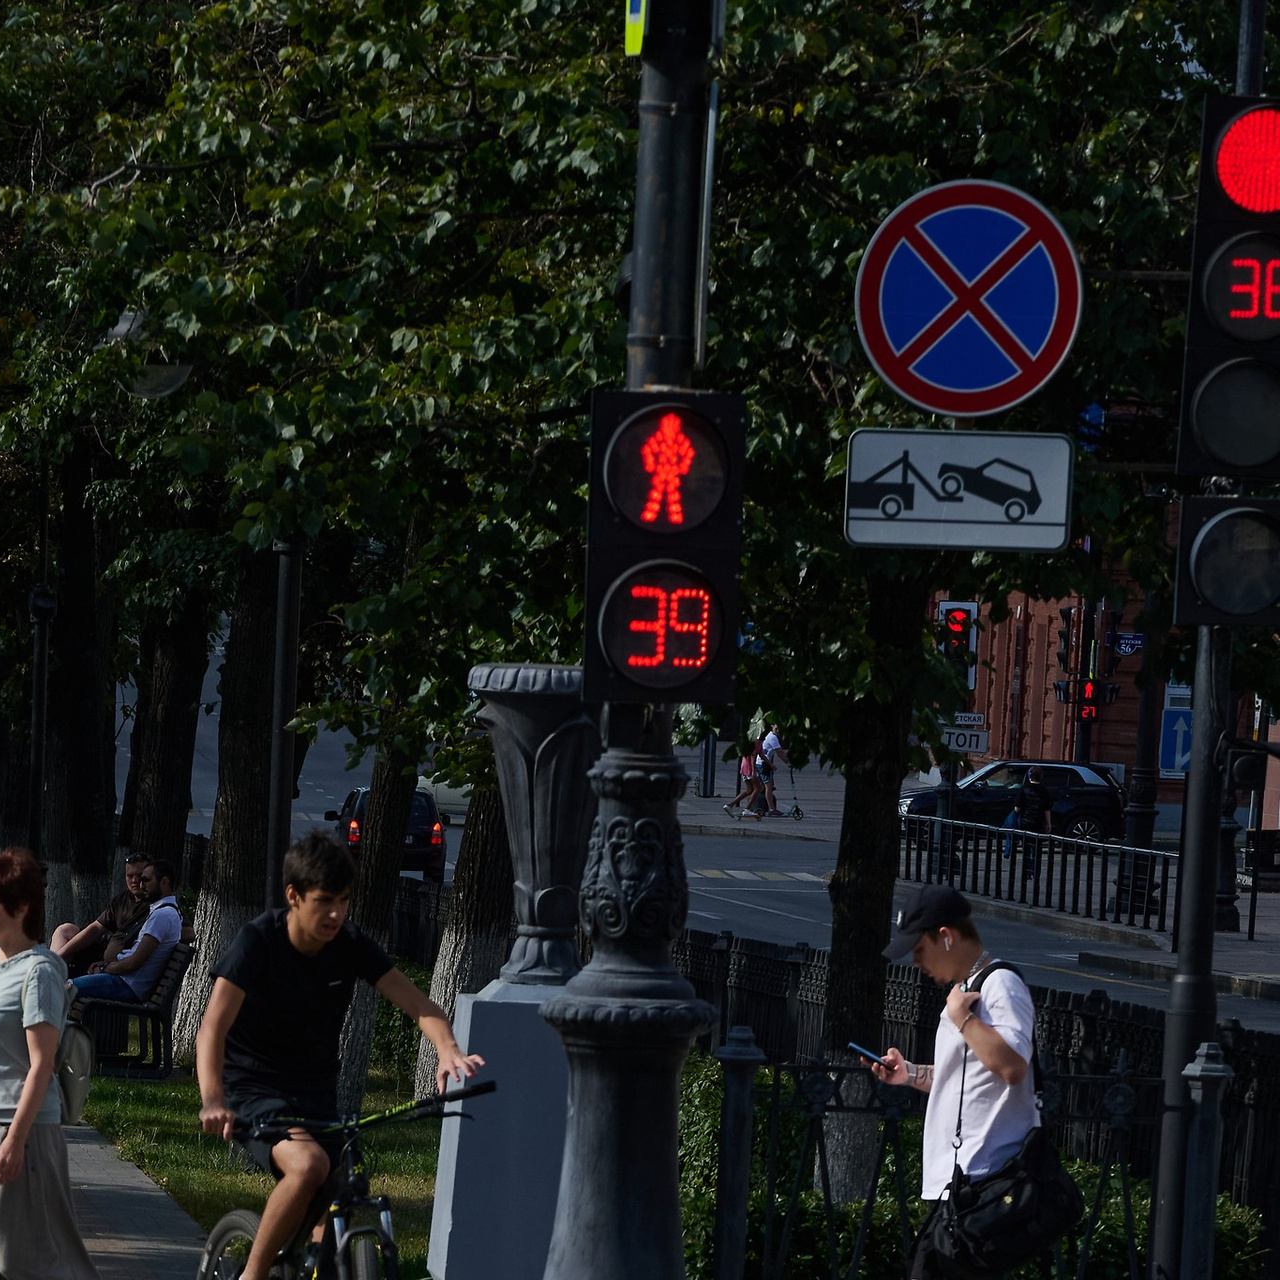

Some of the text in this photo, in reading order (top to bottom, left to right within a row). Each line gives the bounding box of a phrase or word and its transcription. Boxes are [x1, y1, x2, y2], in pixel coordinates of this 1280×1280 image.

[627, 585, 710, 668] 39
[1120, 643, 1132, 653] 56
[956, 715, 982, 723] ЕТСКАЯ
[1081, 705, 1096, 719] 27
[945, 731, 980, 749] ТОП
